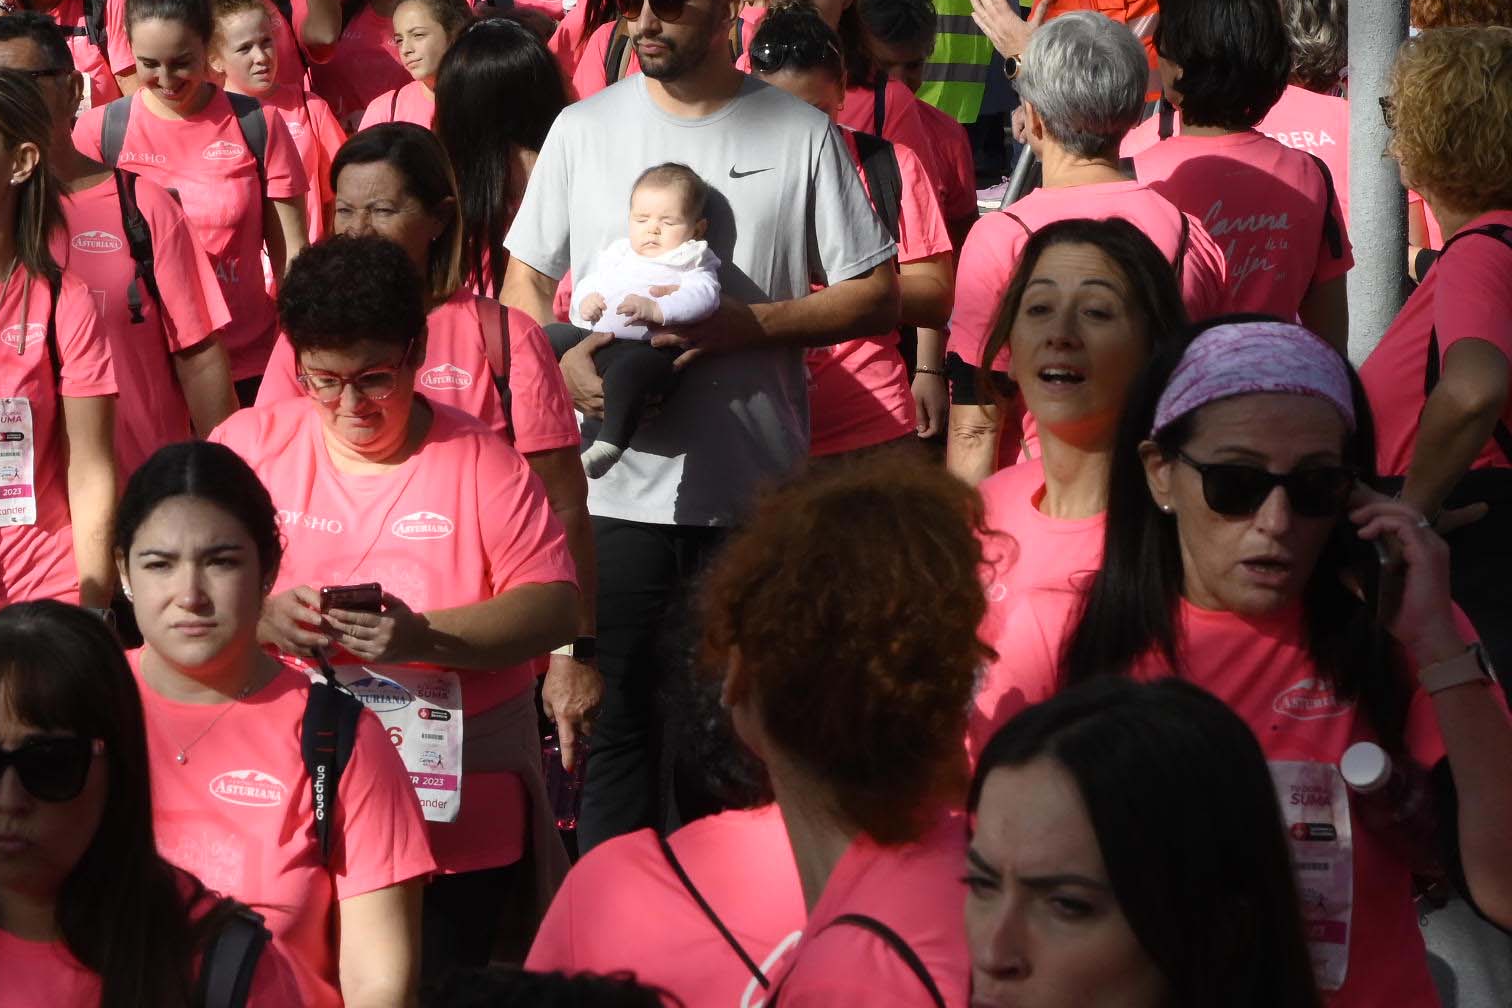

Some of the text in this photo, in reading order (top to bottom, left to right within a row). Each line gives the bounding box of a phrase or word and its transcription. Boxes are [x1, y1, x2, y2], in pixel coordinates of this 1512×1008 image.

[76, 237, 119, 249] ASTURIANA
[3, 488, 22, 496] 2023
[422, 777, 444, 786] 2023
[215, 778, 282, 801] ASTURIANA
[314, 764, 326, 821] Quechua
